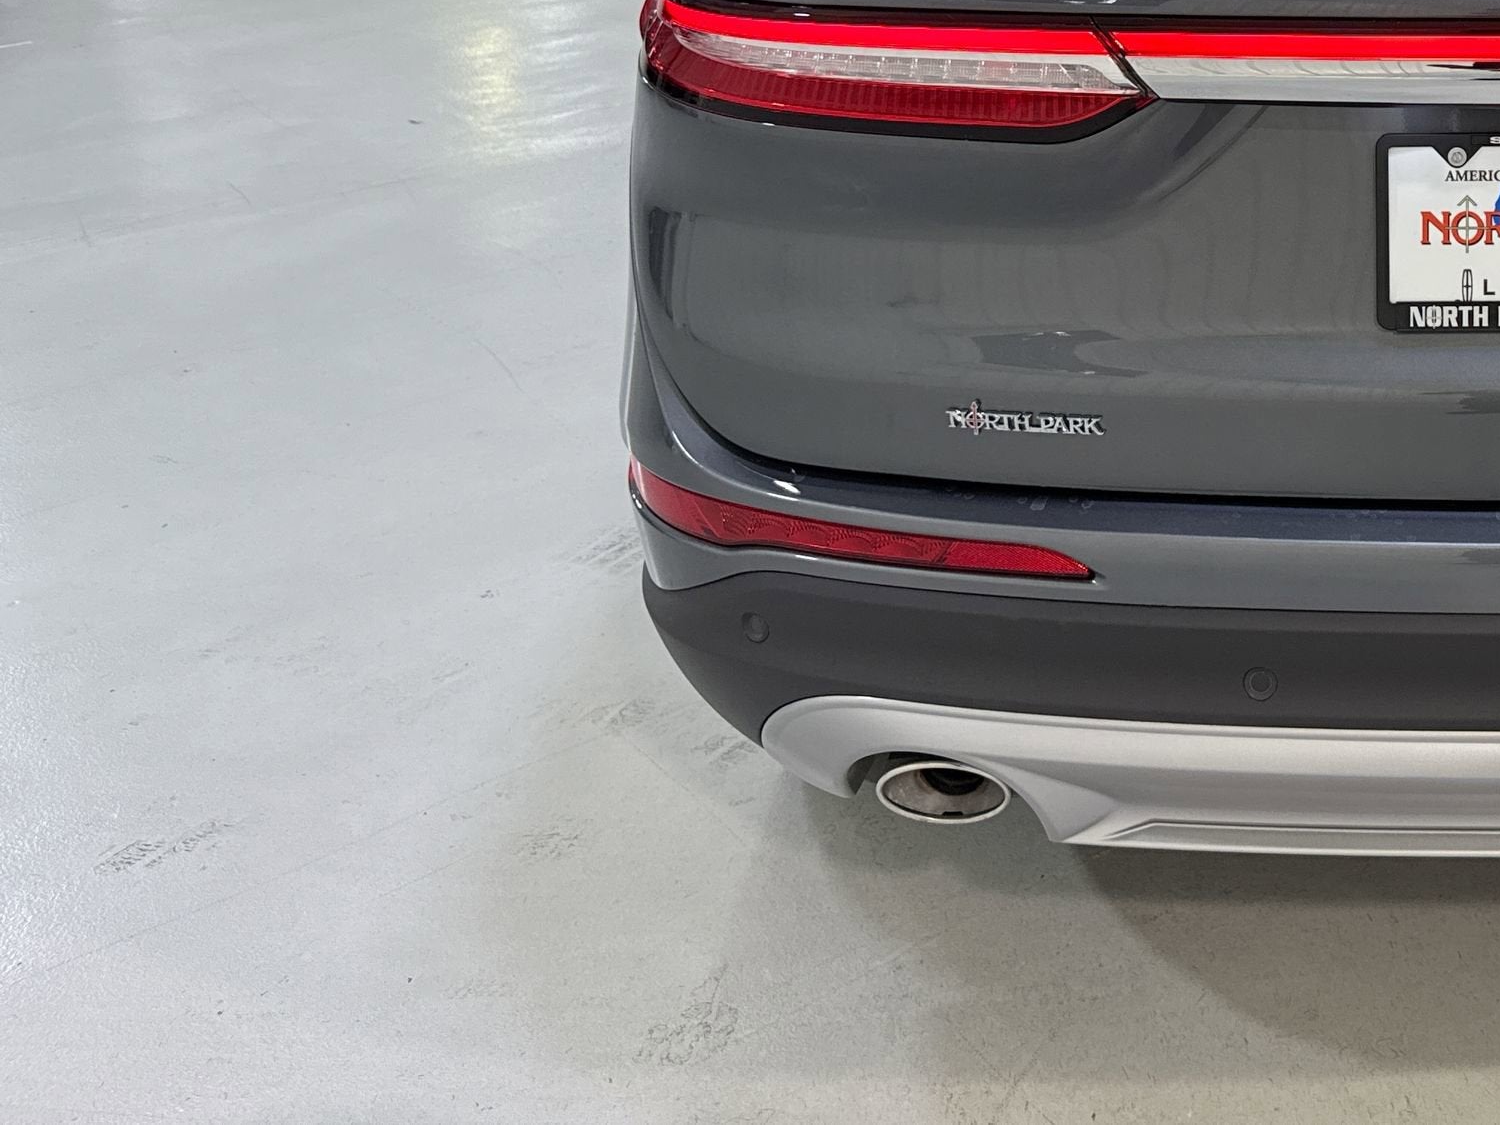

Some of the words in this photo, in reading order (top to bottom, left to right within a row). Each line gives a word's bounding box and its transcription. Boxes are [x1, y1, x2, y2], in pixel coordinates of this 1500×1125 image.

[1409, 305, 1489, 329] NORTH
[945, 409, 1031, 432] NORTH
[1036, 415, 1104, 435] PARK
